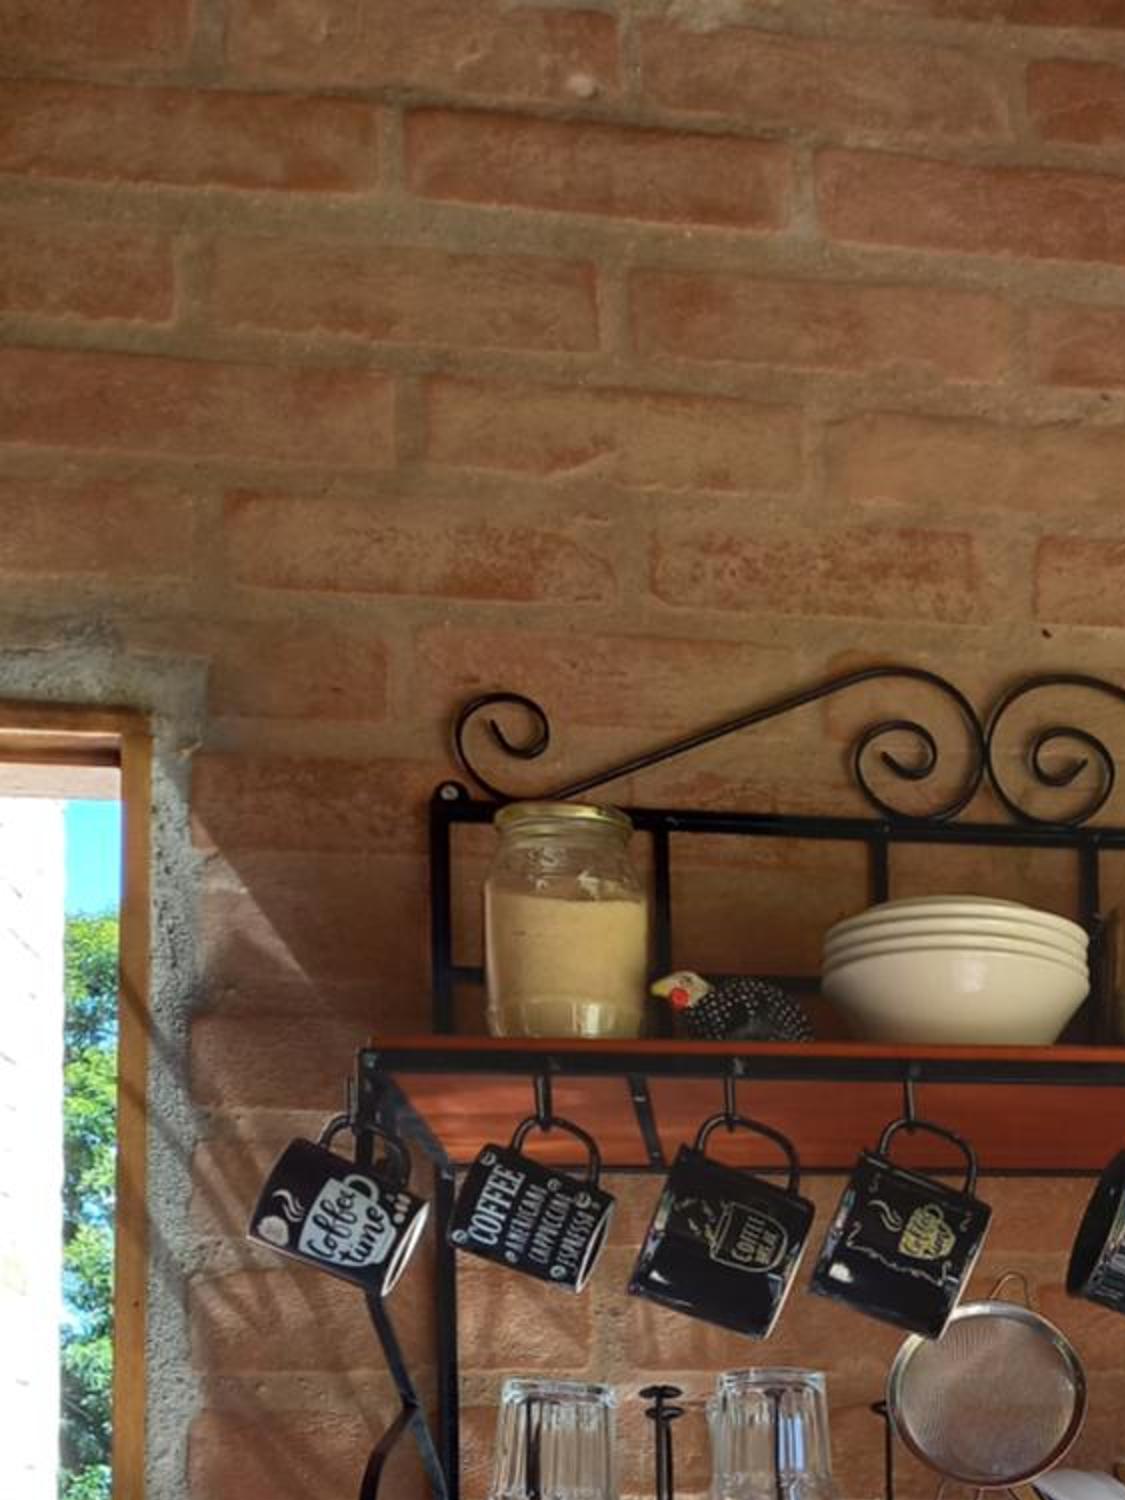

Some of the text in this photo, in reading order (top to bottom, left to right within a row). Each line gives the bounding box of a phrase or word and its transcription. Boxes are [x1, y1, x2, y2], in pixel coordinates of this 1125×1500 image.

[306, 1189, 358, 1259] Coffee
[340, 1205, 386, 1264] time
[467, 1164, 526, 1245] COFFEE
